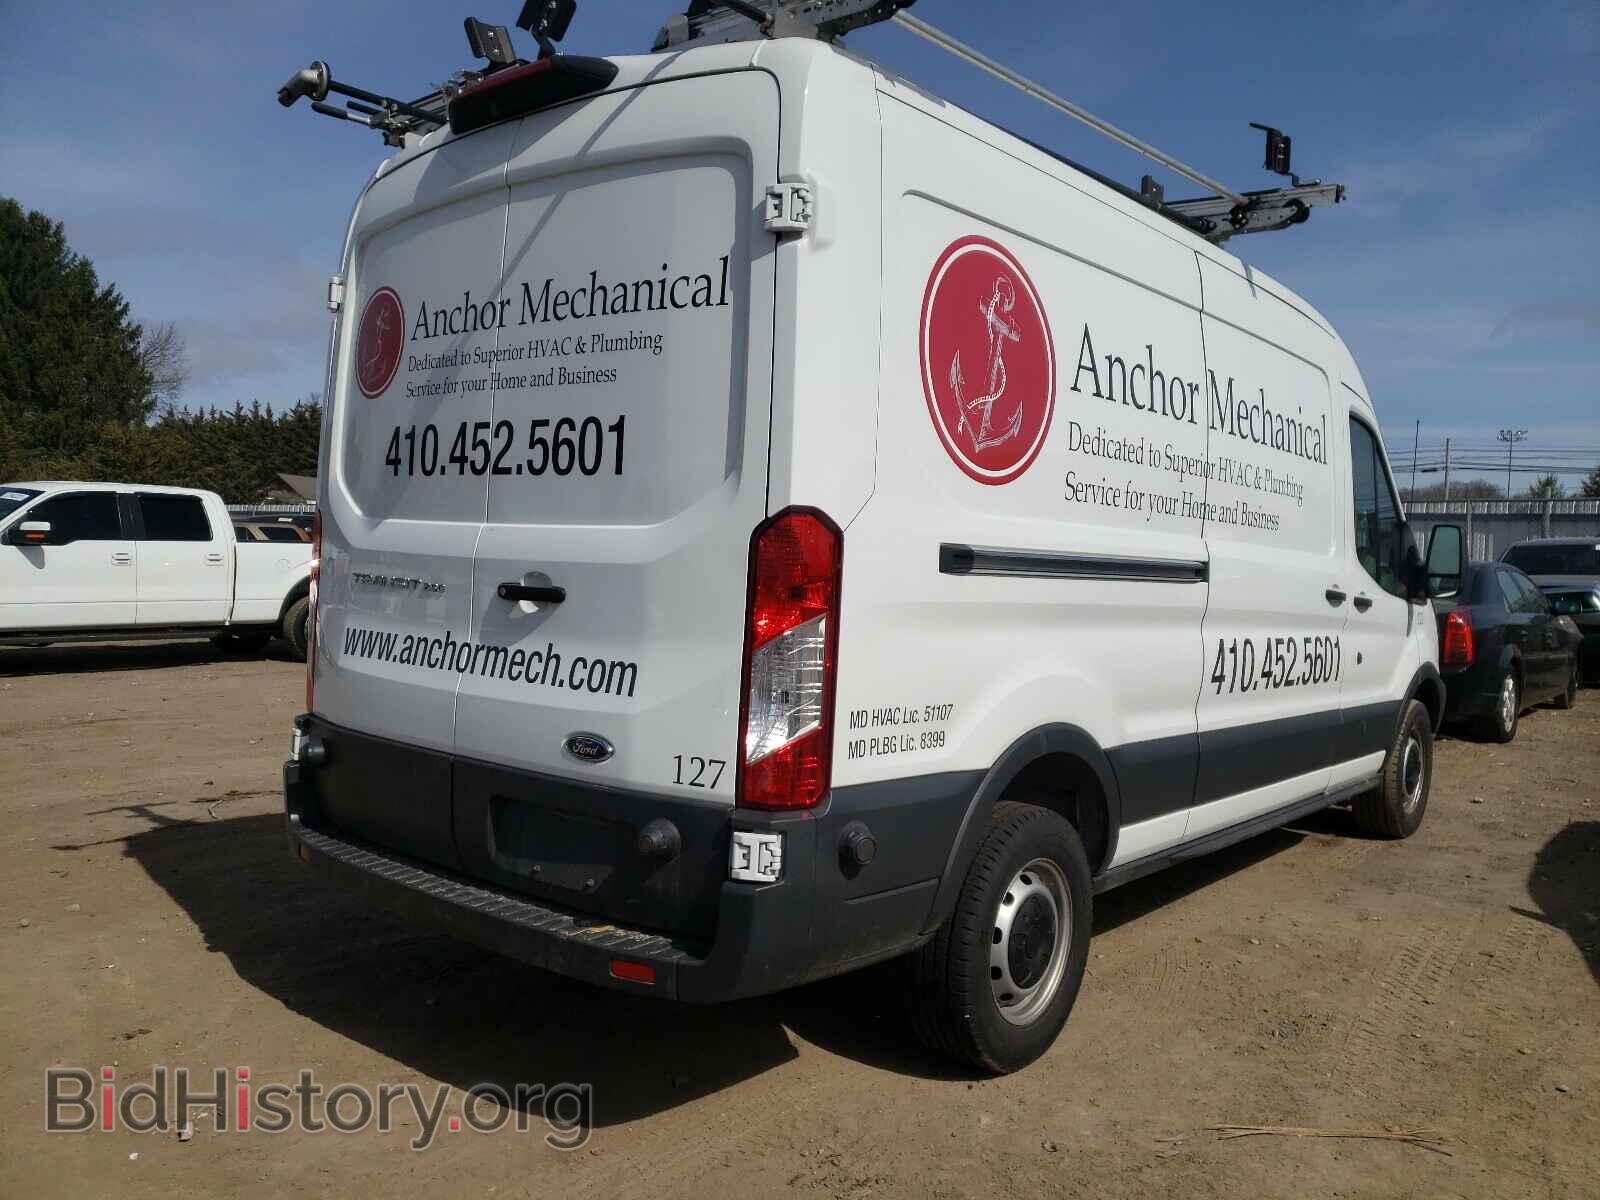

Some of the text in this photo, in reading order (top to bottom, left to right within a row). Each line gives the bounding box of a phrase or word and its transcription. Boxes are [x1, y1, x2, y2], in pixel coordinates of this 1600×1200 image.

[410, 255, 729, 340] Anchor Mechanical
[408, 330, 664, 372] Dedicated to Superior HVAC & Plumbing
[405, 366, 618, 398] Service for your Home and Business
[1070, 323, 1328, 465] Anchor Mechanical
[384, 415, 626, 477] 410.452.5601
[1068, 421, 1303, 507] Dedicated to Superior HVAC & Plumbing
[1064, 471, 1280, 531] Service for your Home and Business
[343, 627, 638, 697] www.anchormech.com
[1211, 635, 1341, 695] 410.452.5601
[848, 730, 945, 760] MD PLBG Lic. 8399
[849, 704, 953, 729] MD HVAC Lic. 51107
[672, 754, 727, 789] 127
